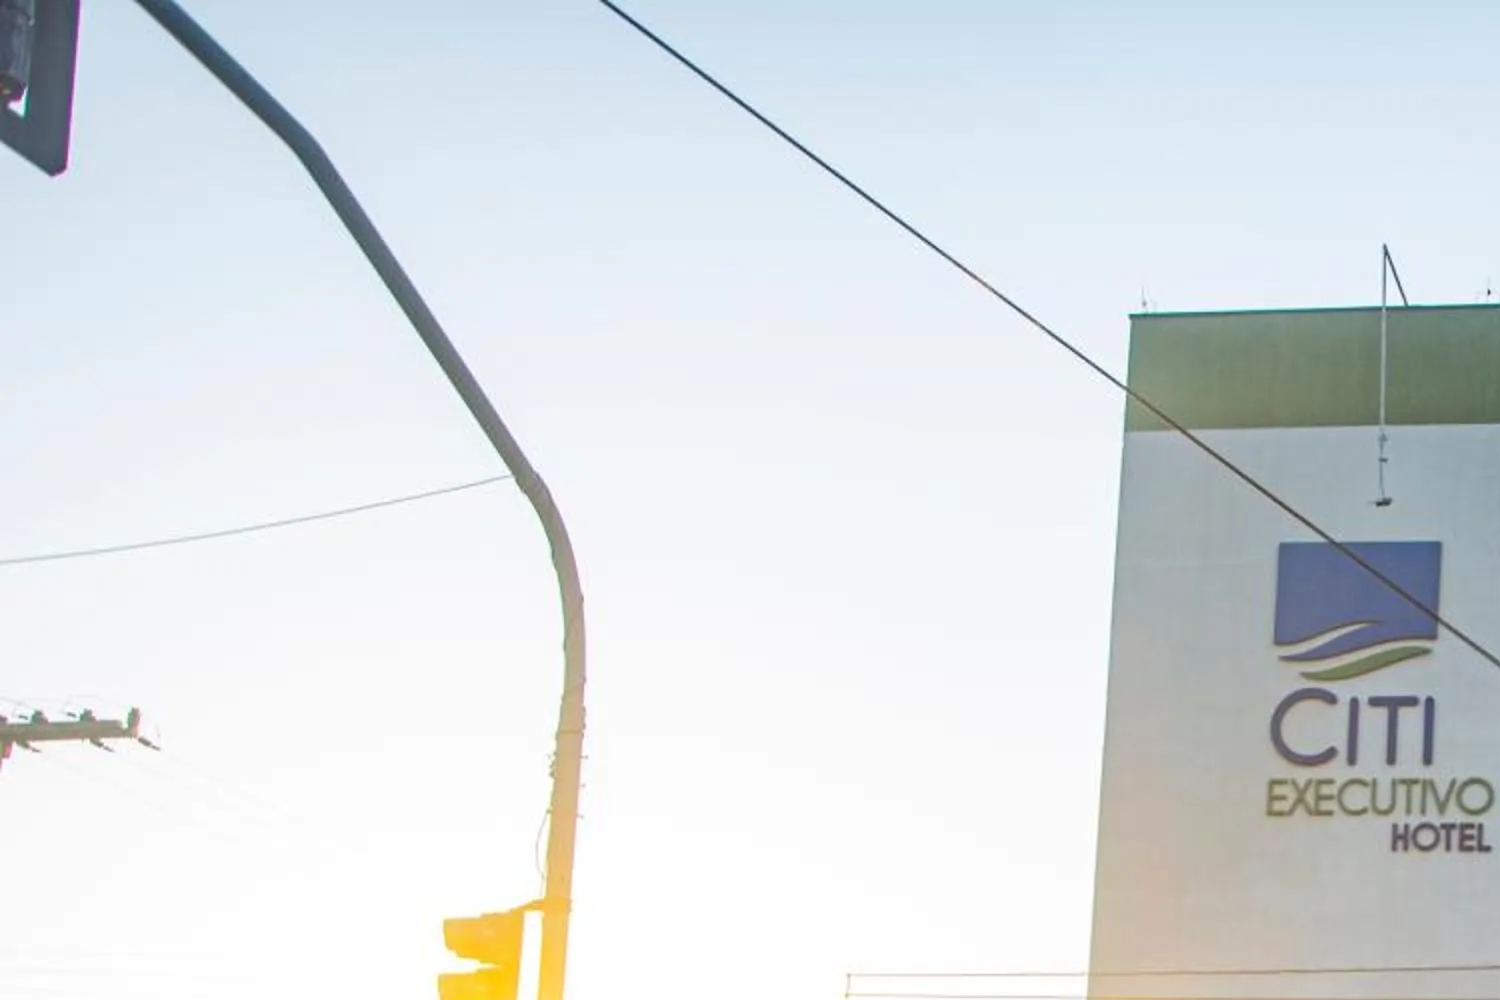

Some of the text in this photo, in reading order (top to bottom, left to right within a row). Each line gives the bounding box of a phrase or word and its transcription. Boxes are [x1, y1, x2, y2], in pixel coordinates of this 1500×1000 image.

[1270, 687, 1435, 767] CITI
[1265, 777, 1495, 817] EXECUTIVO
[1391, 823, 1492, 852] HOTEL
